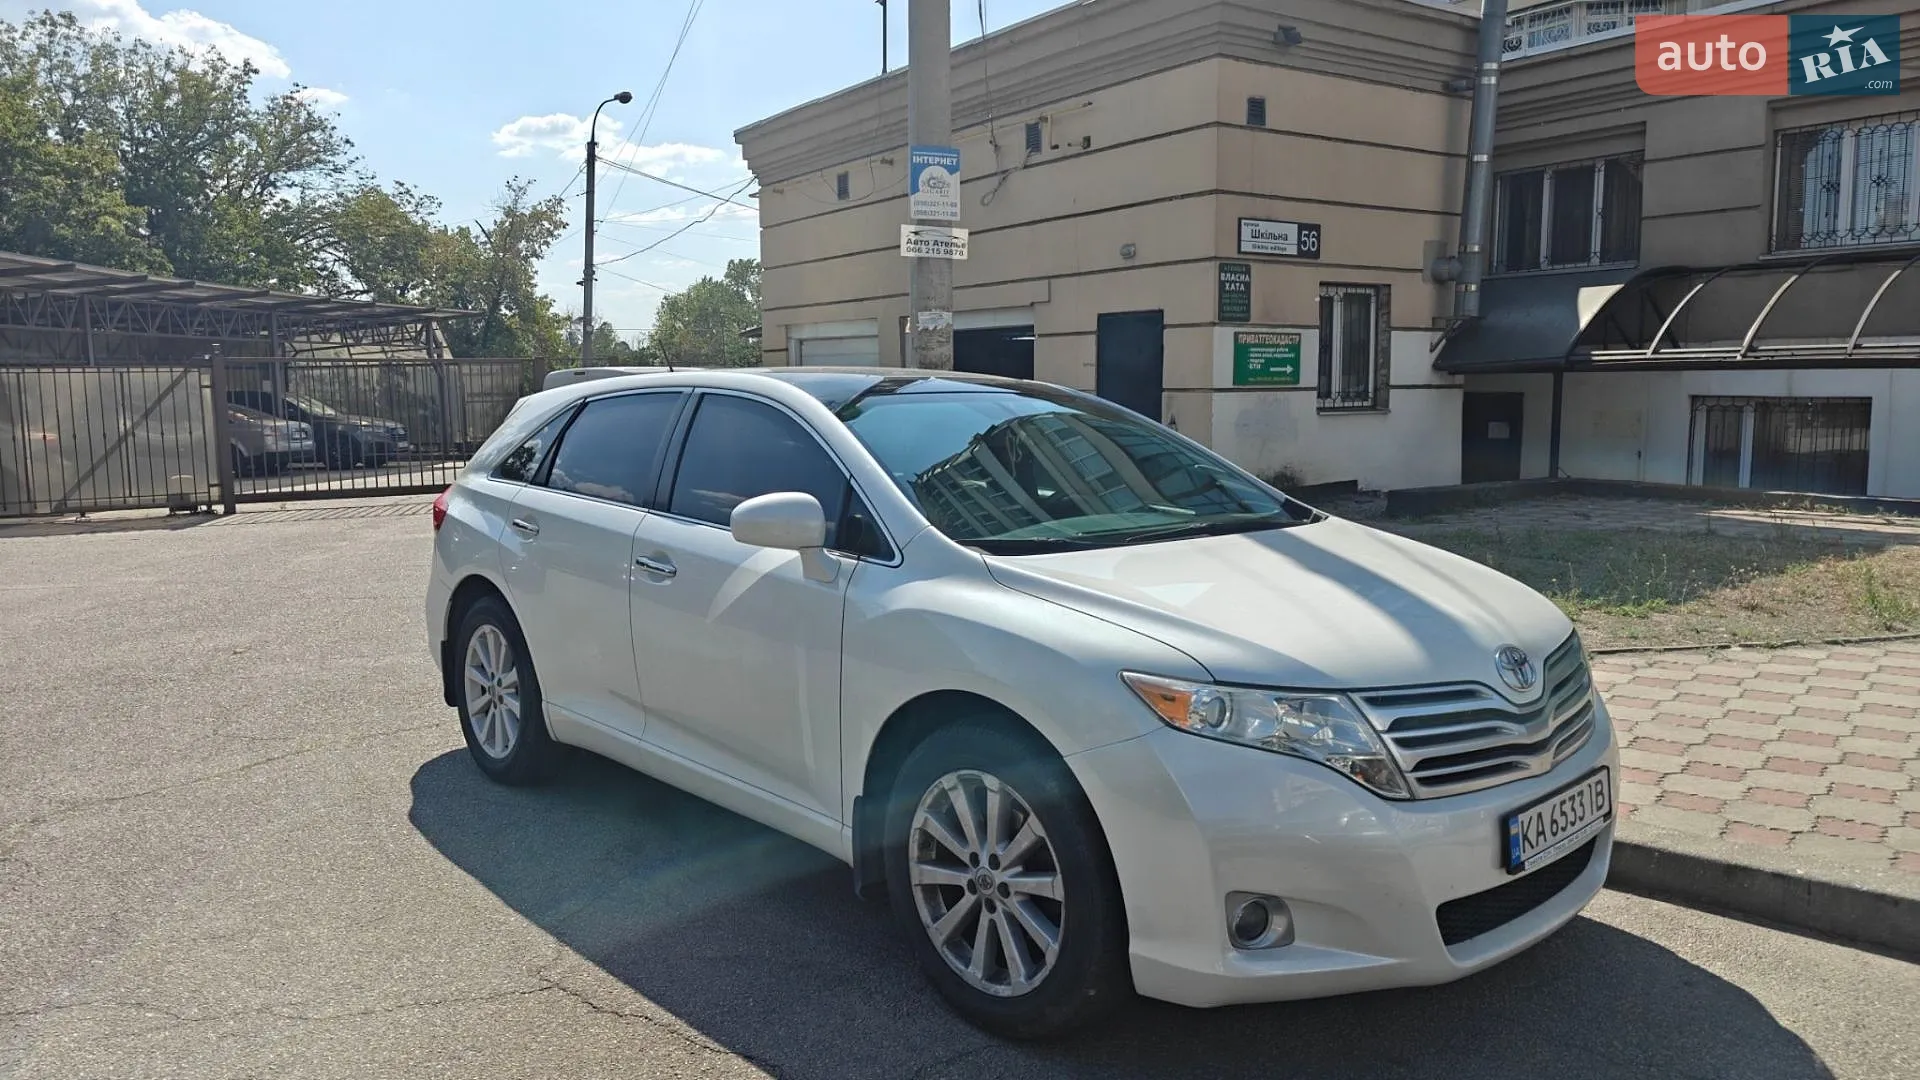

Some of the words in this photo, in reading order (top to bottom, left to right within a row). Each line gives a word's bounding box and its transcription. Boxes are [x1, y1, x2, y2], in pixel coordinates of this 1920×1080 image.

[912, 155, 958, 166] ІНТЕРНЕТ
[1250, 228, 1289, 242] Шкільна
[906, 238, 930, 247] Авто
[1300, 230, 1318, 252] 56
[925, 247, 941, 256] 215
[1220, 272, 1250, 282] ВЛАСНА
[1225, 281, 1245, 291] ХАТА
[1520, 811, 1548, 854] KA
[1550, 790, 1586, 837] 6533
